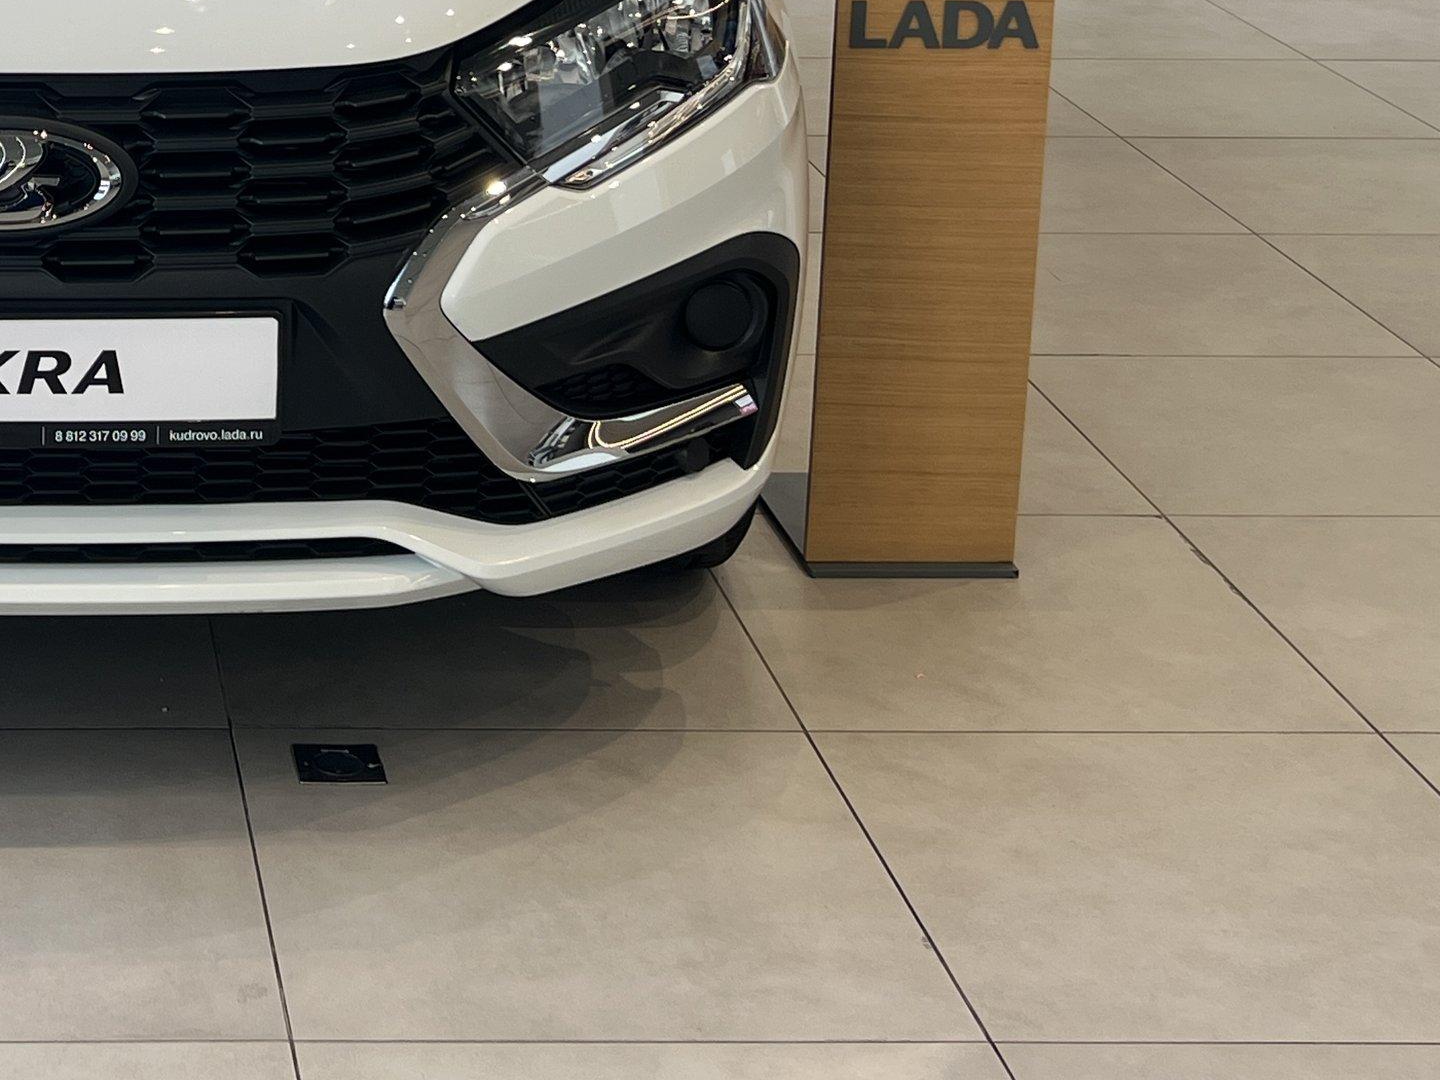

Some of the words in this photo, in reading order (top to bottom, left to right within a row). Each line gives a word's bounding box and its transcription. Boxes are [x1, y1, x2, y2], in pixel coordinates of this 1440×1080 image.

[849, 0, 1039, 49] LADA
[54, 431, 62, 441] 8
[65, 431, 86, 441] 812
[89, 431, 109, 442] 317
[112, 431, 128, 442] 09
[131, 431, 146, 442] 99
[169, 430, 263, 441] kudrovo.lada.ru
